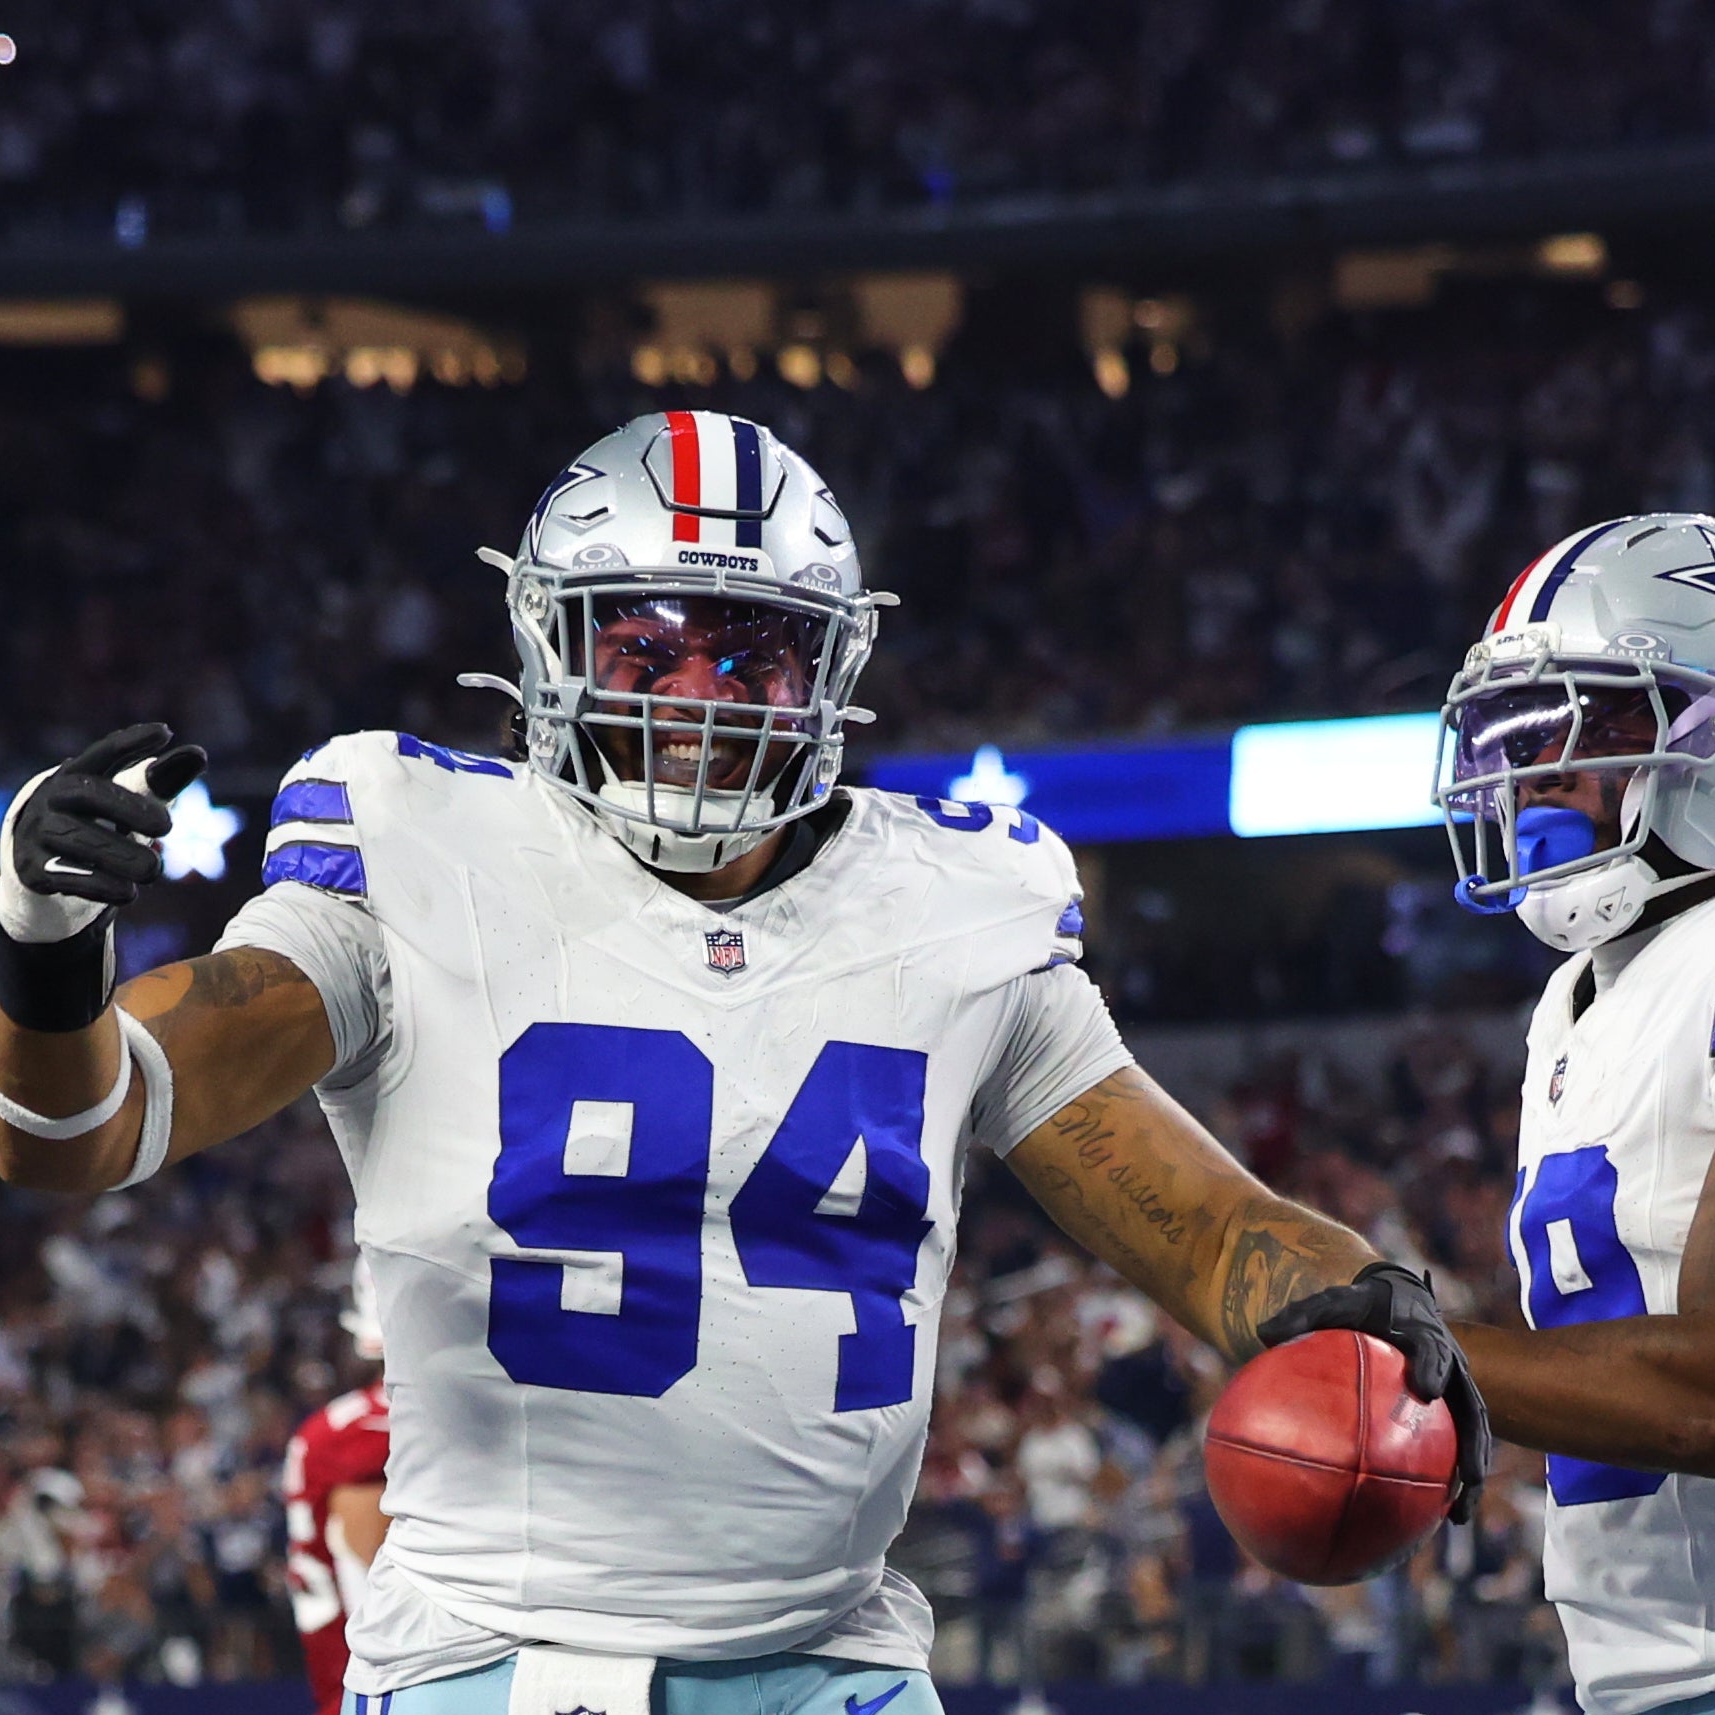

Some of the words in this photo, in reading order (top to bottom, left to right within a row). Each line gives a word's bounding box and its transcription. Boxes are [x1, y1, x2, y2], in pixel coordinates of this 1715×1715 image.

[678, 550, 759, 572] COWBOYS
[1607, 647, 1666, 660] OAKLEY
[487, 1022, 936, 1413] 94
